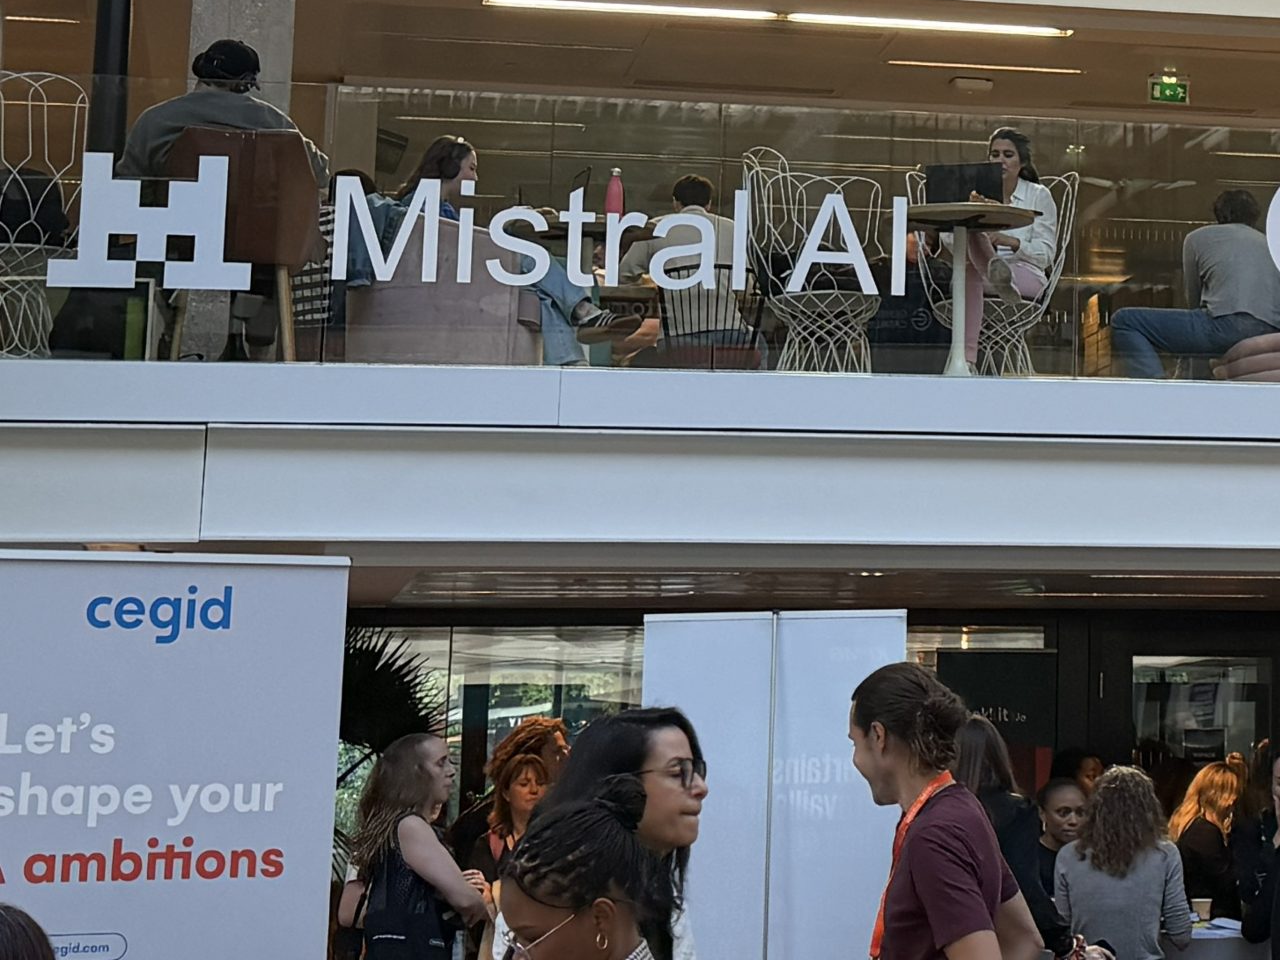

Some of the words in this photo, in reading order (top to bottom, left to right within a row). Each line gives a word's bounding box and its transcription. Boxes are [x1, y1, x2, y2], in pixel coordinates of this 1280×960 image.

[331, 175, 748, 291] Mistral
[786, 193, 909, 296] AI
[86, 585, 233, 644] cegid
[0, 712, 116, 754] Let's
[167, 782, 284, 826] your
[23, 836, 285, 885] ambitions
